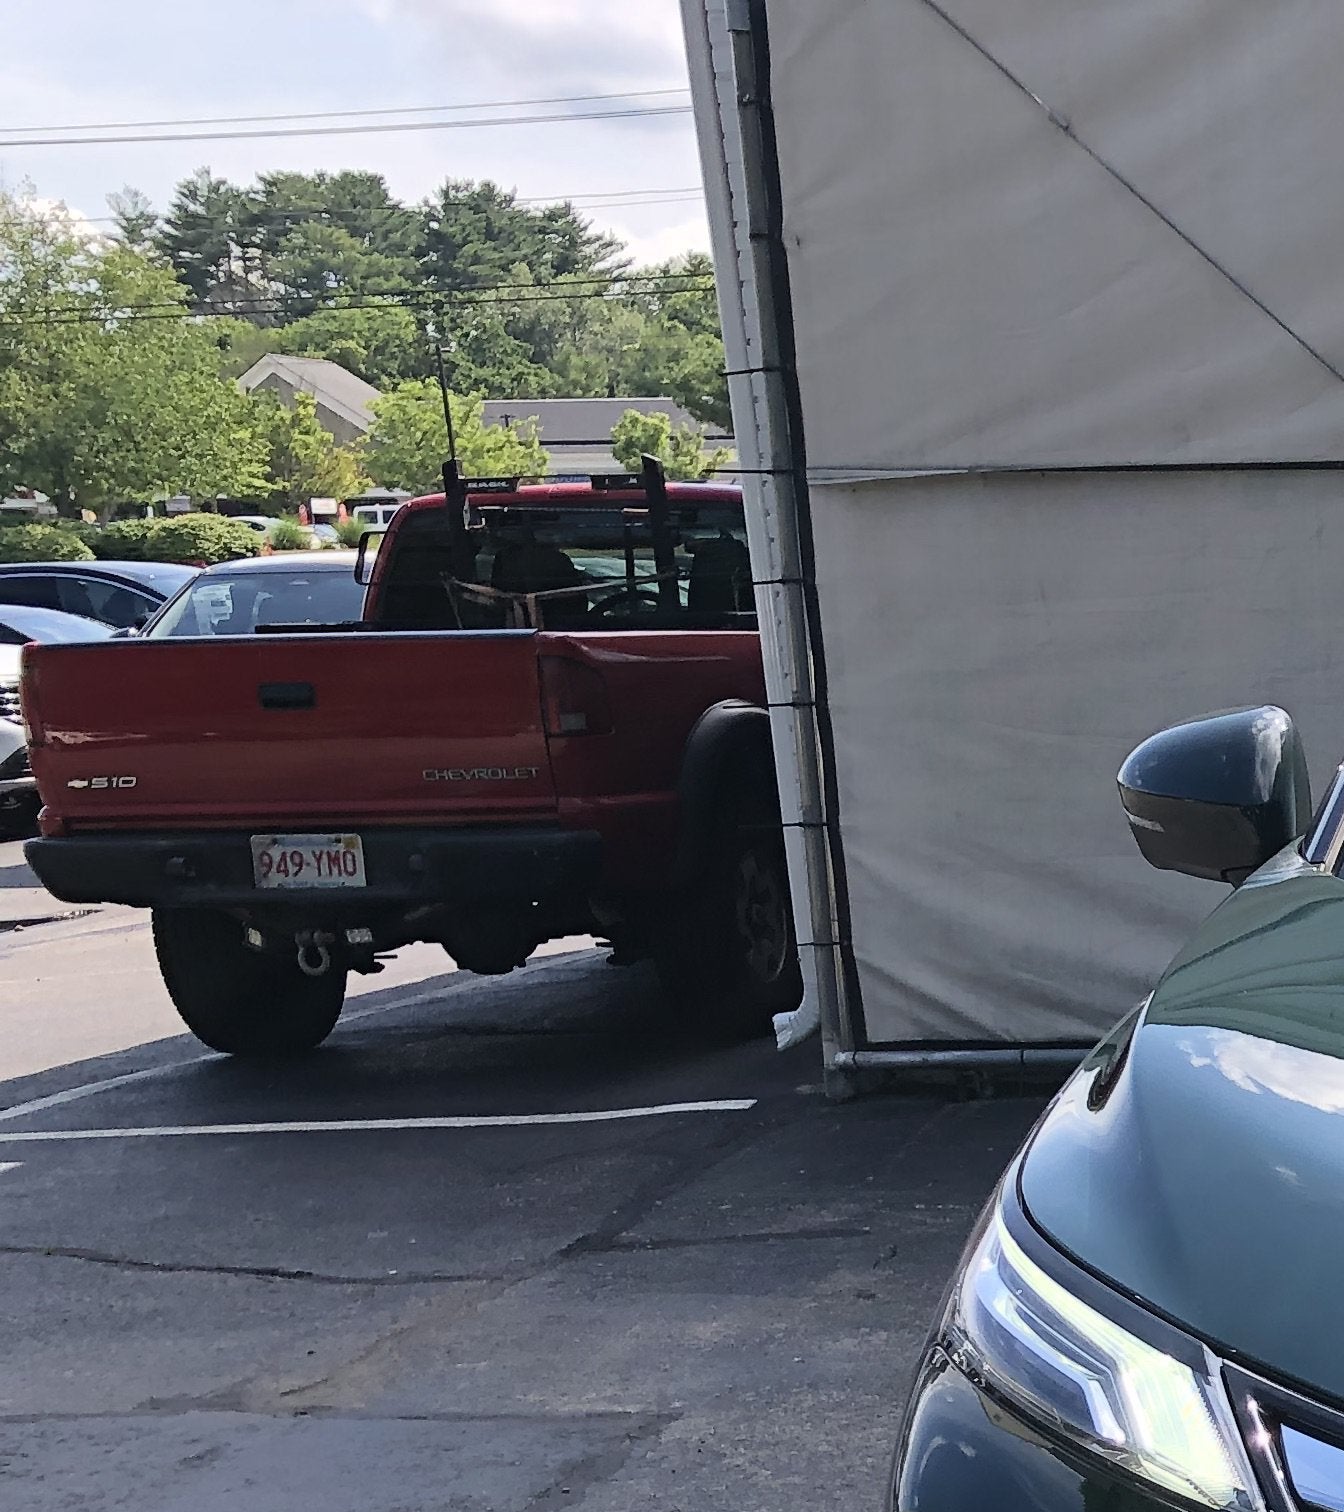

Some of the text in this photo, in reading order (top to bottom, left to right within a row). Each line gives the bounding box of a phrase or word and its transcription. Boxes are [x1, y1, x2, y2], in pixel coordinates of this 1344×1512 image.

[422, 767, 540, 781] CHEVROLET
[90, 776, 137, 789] S10
[259, 850, 358, 878] 949-YMO
